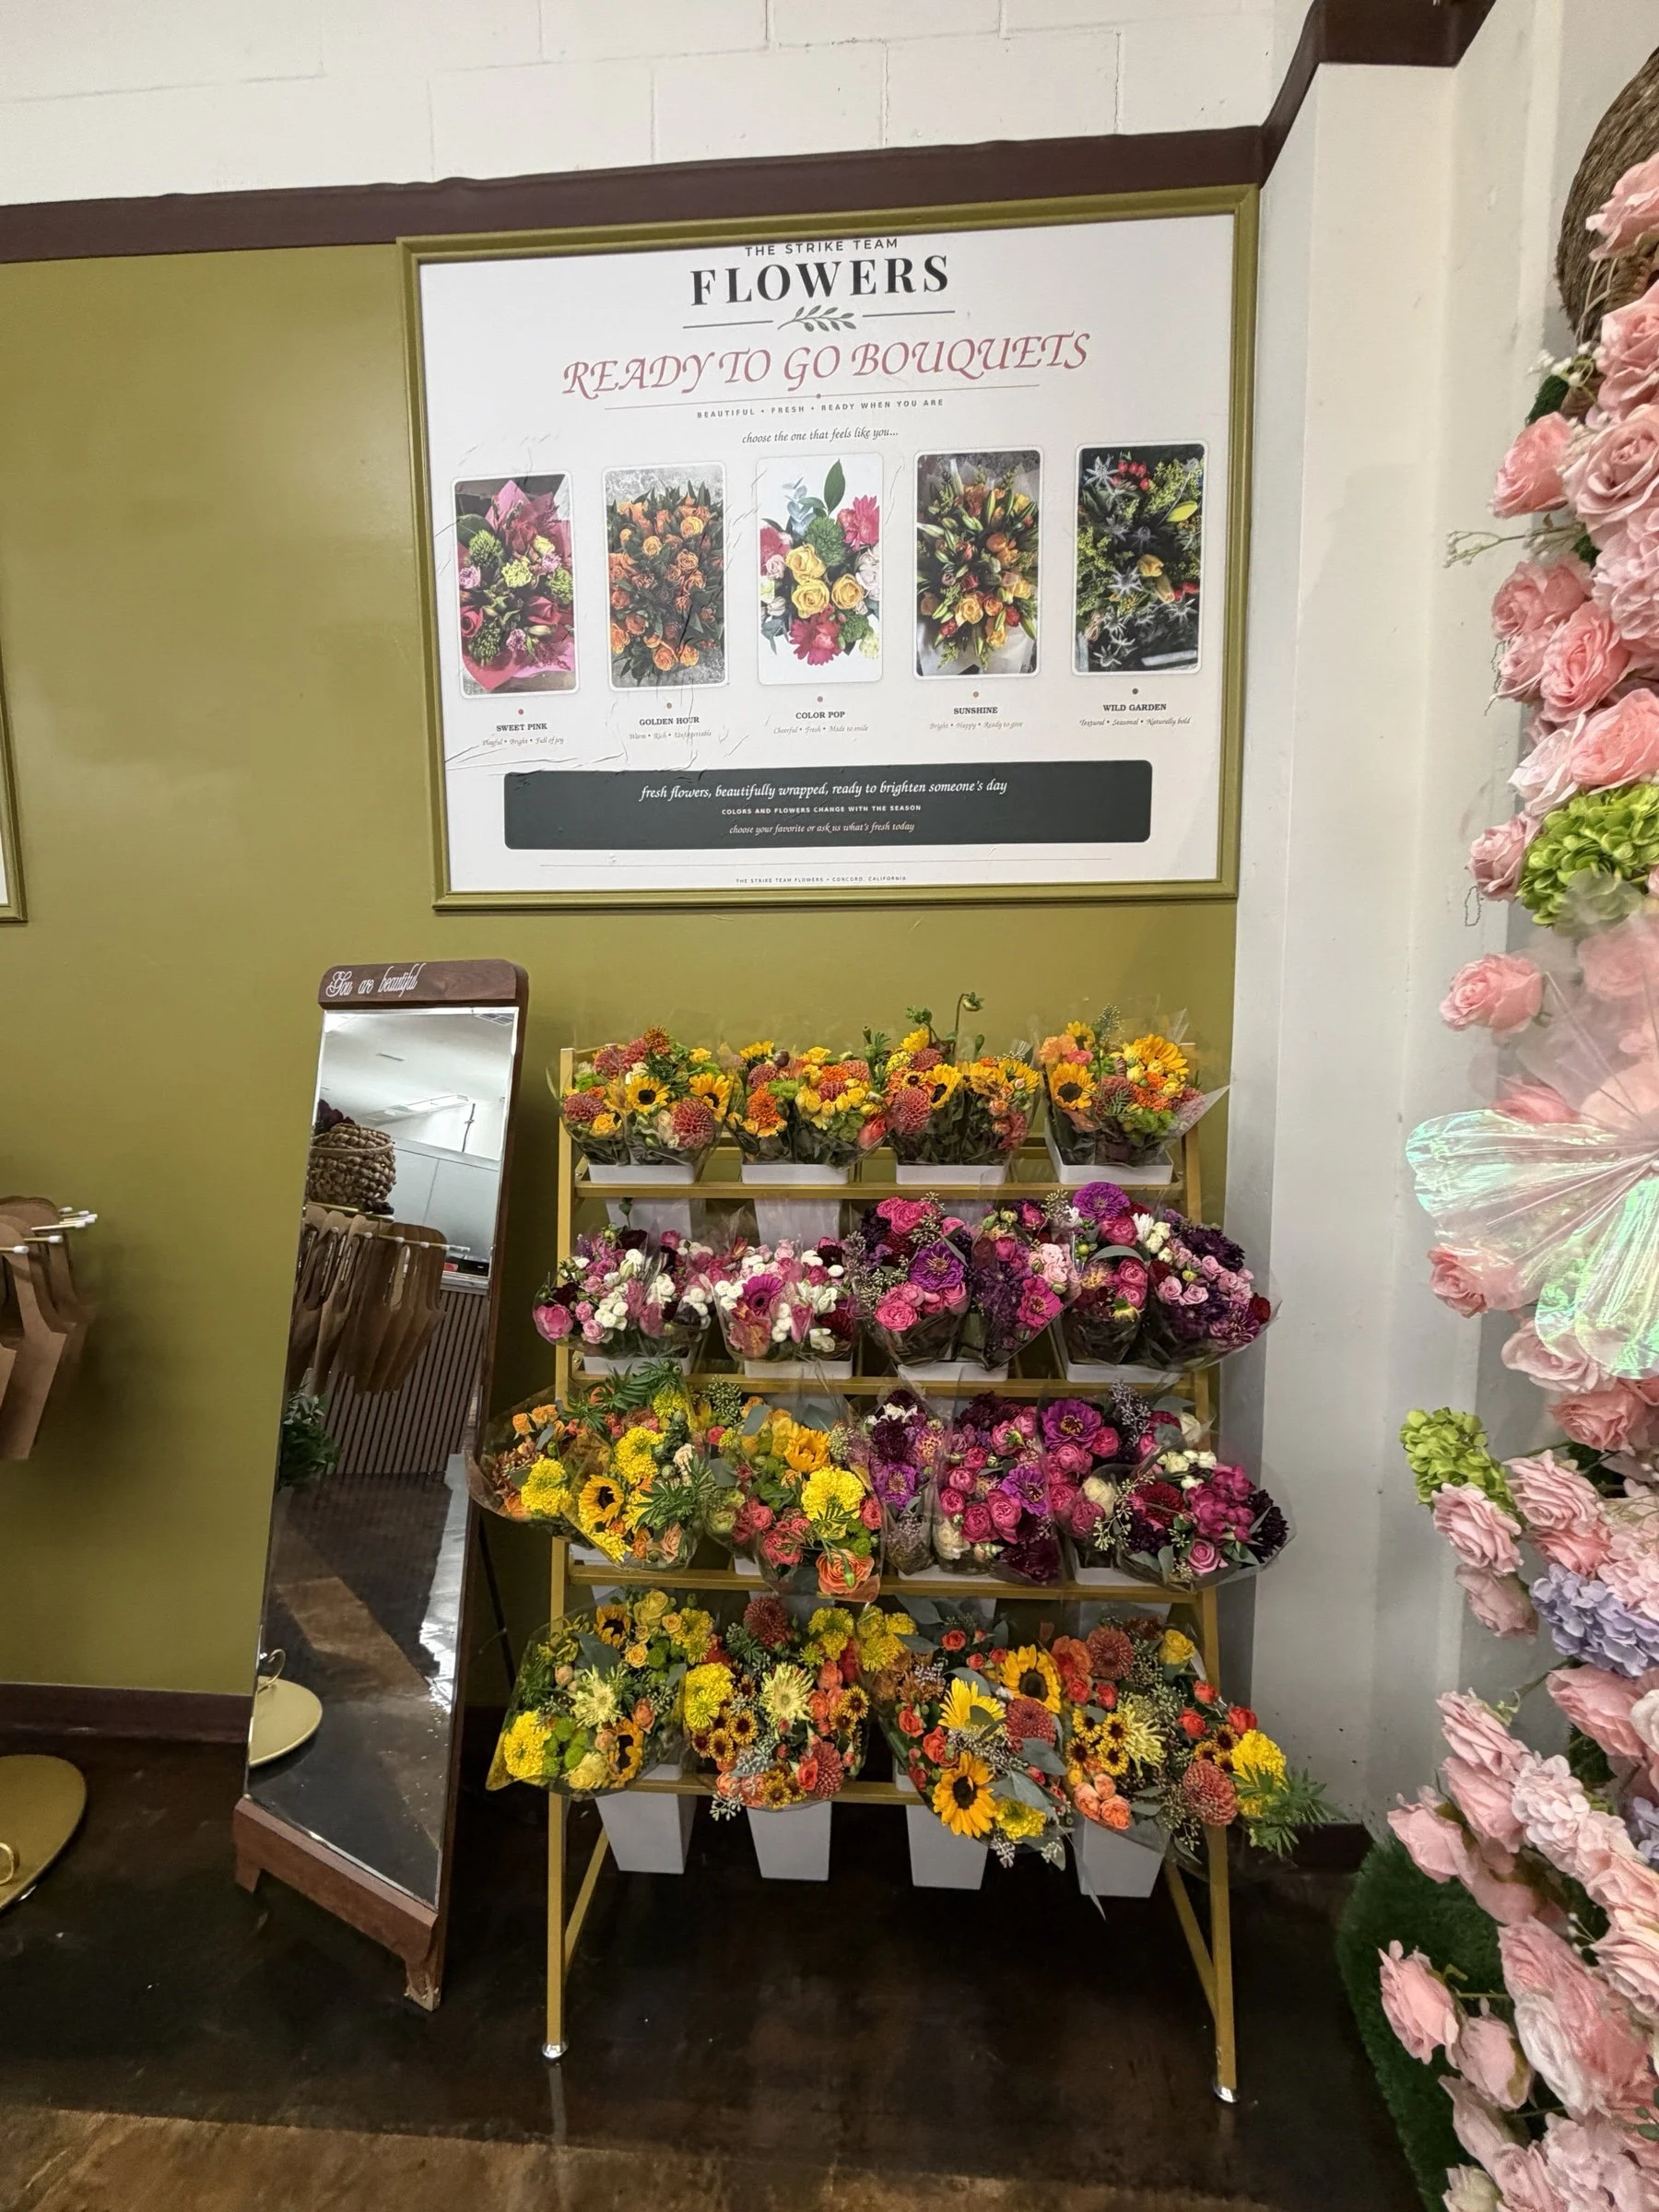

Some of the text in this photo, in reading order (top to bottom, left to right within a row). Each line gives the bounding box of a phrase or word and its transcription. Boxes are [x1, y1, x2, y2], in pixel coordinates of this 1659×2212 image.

[745, 238, 899, 258] THE STRIKE TEAM
[689, 254, 949, 307] FLOWERS
[562, 333, 1092, 400] READY TO GO BOUQUETS
[697, 398, 944, 418] BEAUTIFUL FRESH READY WHEN YOU ARE
[742, 427, 900, 444] choose the one that feels like you...
[795, 711, 845, 719] COLOR POP
[953, 706, 999, 715] SUNSHINE
[1103, 703, 1167, 712] WILD GARDEN
[496, 723, 548, 733] SWEET PINK
[639, 716, 700, 726] GOLDEN HOUR
[1112, 718, 1139, 726] Seasonal
[1146, 717, 1177, 726] Naturally
[1177, 715, 1192, 725] bold
[639, 785, 666, 802] fresh
[668, 785, 712, 802] flowers,
[715, 783, 776, 800] beautifully
[778, 782, 829, 799] wrapped,
[832, 782, 862, 797] ready
[865, 783, 877, 794] to
[879, 781, 925, 796] brighten
[986, 779, 1007, 794] day
[729, 824, 754, 834] choose
[756, 826, 772, 836] your
[774, 824, 805, 835] favorite
[817, 823, 831, 833] ask
[869, 821, 890, 833] fresh
[892, 822, 914, 833] today
[325, 962, 427, 998] You are beautiful
